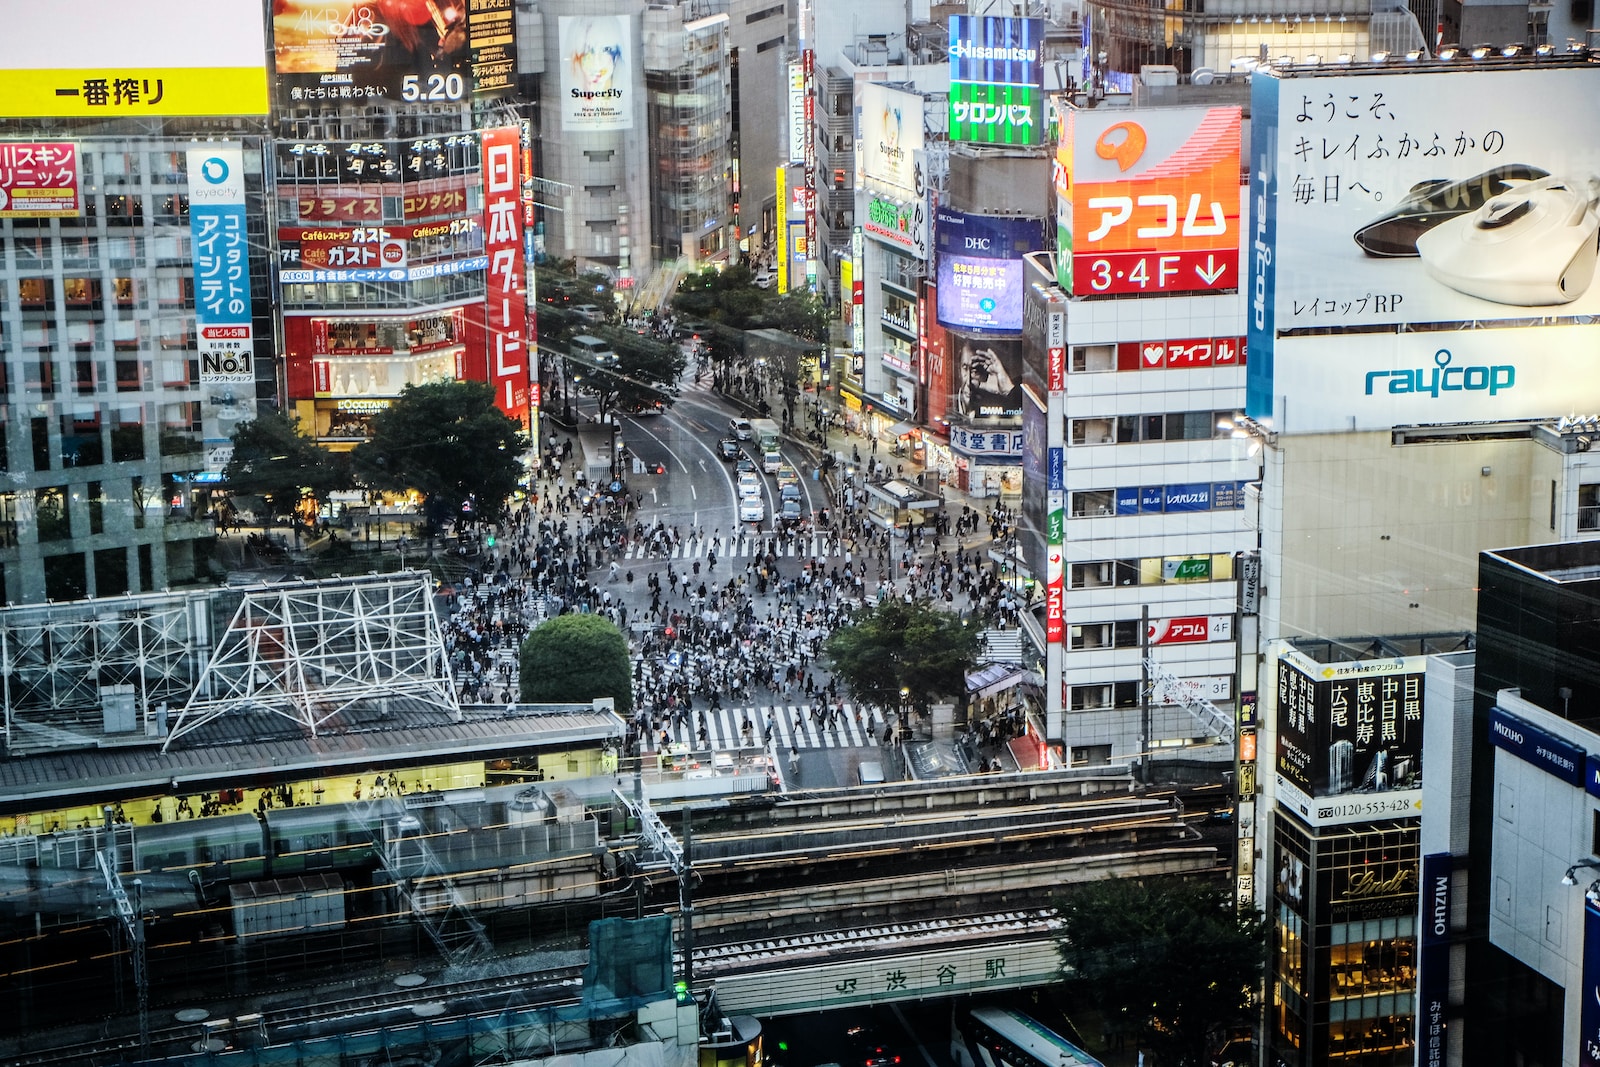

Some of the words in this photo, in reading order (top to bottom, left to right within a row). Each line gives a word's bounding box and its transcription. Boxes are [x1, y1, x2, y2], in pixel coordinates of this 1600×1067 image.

[294, 7, 373, 37] AKB48
[949, 39, 1036, 61] Hisamitsu
[55, 78, 164, 106] 一番搾り
[290, 85, 388, 99] 僕たちは戦わない
[402, 73, 463, 101] 5.20
[571, 88, 623, 100] Superfly
[954, 100, 1033, 127] サロンパス
[1296, 93, 1395, 123] ようこそ、
[879, 141, 906, 162] Superfly
[1293, 130, 1504, 162] キレイふかふかの
[196, 187, 238, 200] eyecity
[1292, 173, 1383, 205] 毎日へ。
[300, 198, 379, 216] プライス
[404, 191, 464, 213] コンタクト
[449, 218, 478, 236] ガスト
[1087, 193, 1227, 242] アコム
[351, 227, 391, 244] ガスト
[964, 237, 991, 250] DHC
[280, 249, 300, 262] 7F
[303, 248, 326, 258] Café
[328, 245, 377, 266] ガスト
[1255, 169, 1272, 331] raycop
[197, 215, 223, 315] アイシティ
[224, 215, 245, 316] コンタクトの
[315, 270, 387, 282] 英会話イーオン
[434, 258, 487, 275] 英会話イーオン
[487, 144, 521, 409] 日本ダービー
[1293, 292, 1404, 317] レイコップRP
[207, 328, 247, 338] 当ビル5階
[202, 352, 253, 375] No.1
[1169, 343, 1234, 363] アイフル
[201, 374, 253, 383] コンタクトショップ
[1051, 357, 1061, 390] アイフル
[1364, 349, 1516, 398] raycop
[952, 426, 1023, 451] 大盛堂書店
[1166, 491, 1209, 505] レオパレス21
[1051, 515, 1060, 540] レイク
[1182, 563, 1207, 574] レイク
[1049, 587, 1061, 619] アコム
[1171, 624, 1206, 637] アコム
[1213, 622, 1229, 633] 4F
[1212, 683, 1228, 694] 3F
[1404, 677, 1421, 721] 目黒
[1331, 685, 1350, 728] 広尾
[1356, 682, 1376, 745] 恵比寿
[1381, 677, 1399, 742] 中目黒
[1493, 721, 1525, 745] MIZUHO
[1334, 799, 1410, 818] 0120-553-428
[1342, 870, 1409, 896] Lindt
[1434, 876, 1448, 936] MIZUHO
[836, 978, 857, 992] JR
[886, 958, 1006, 992] 渋谷駅
